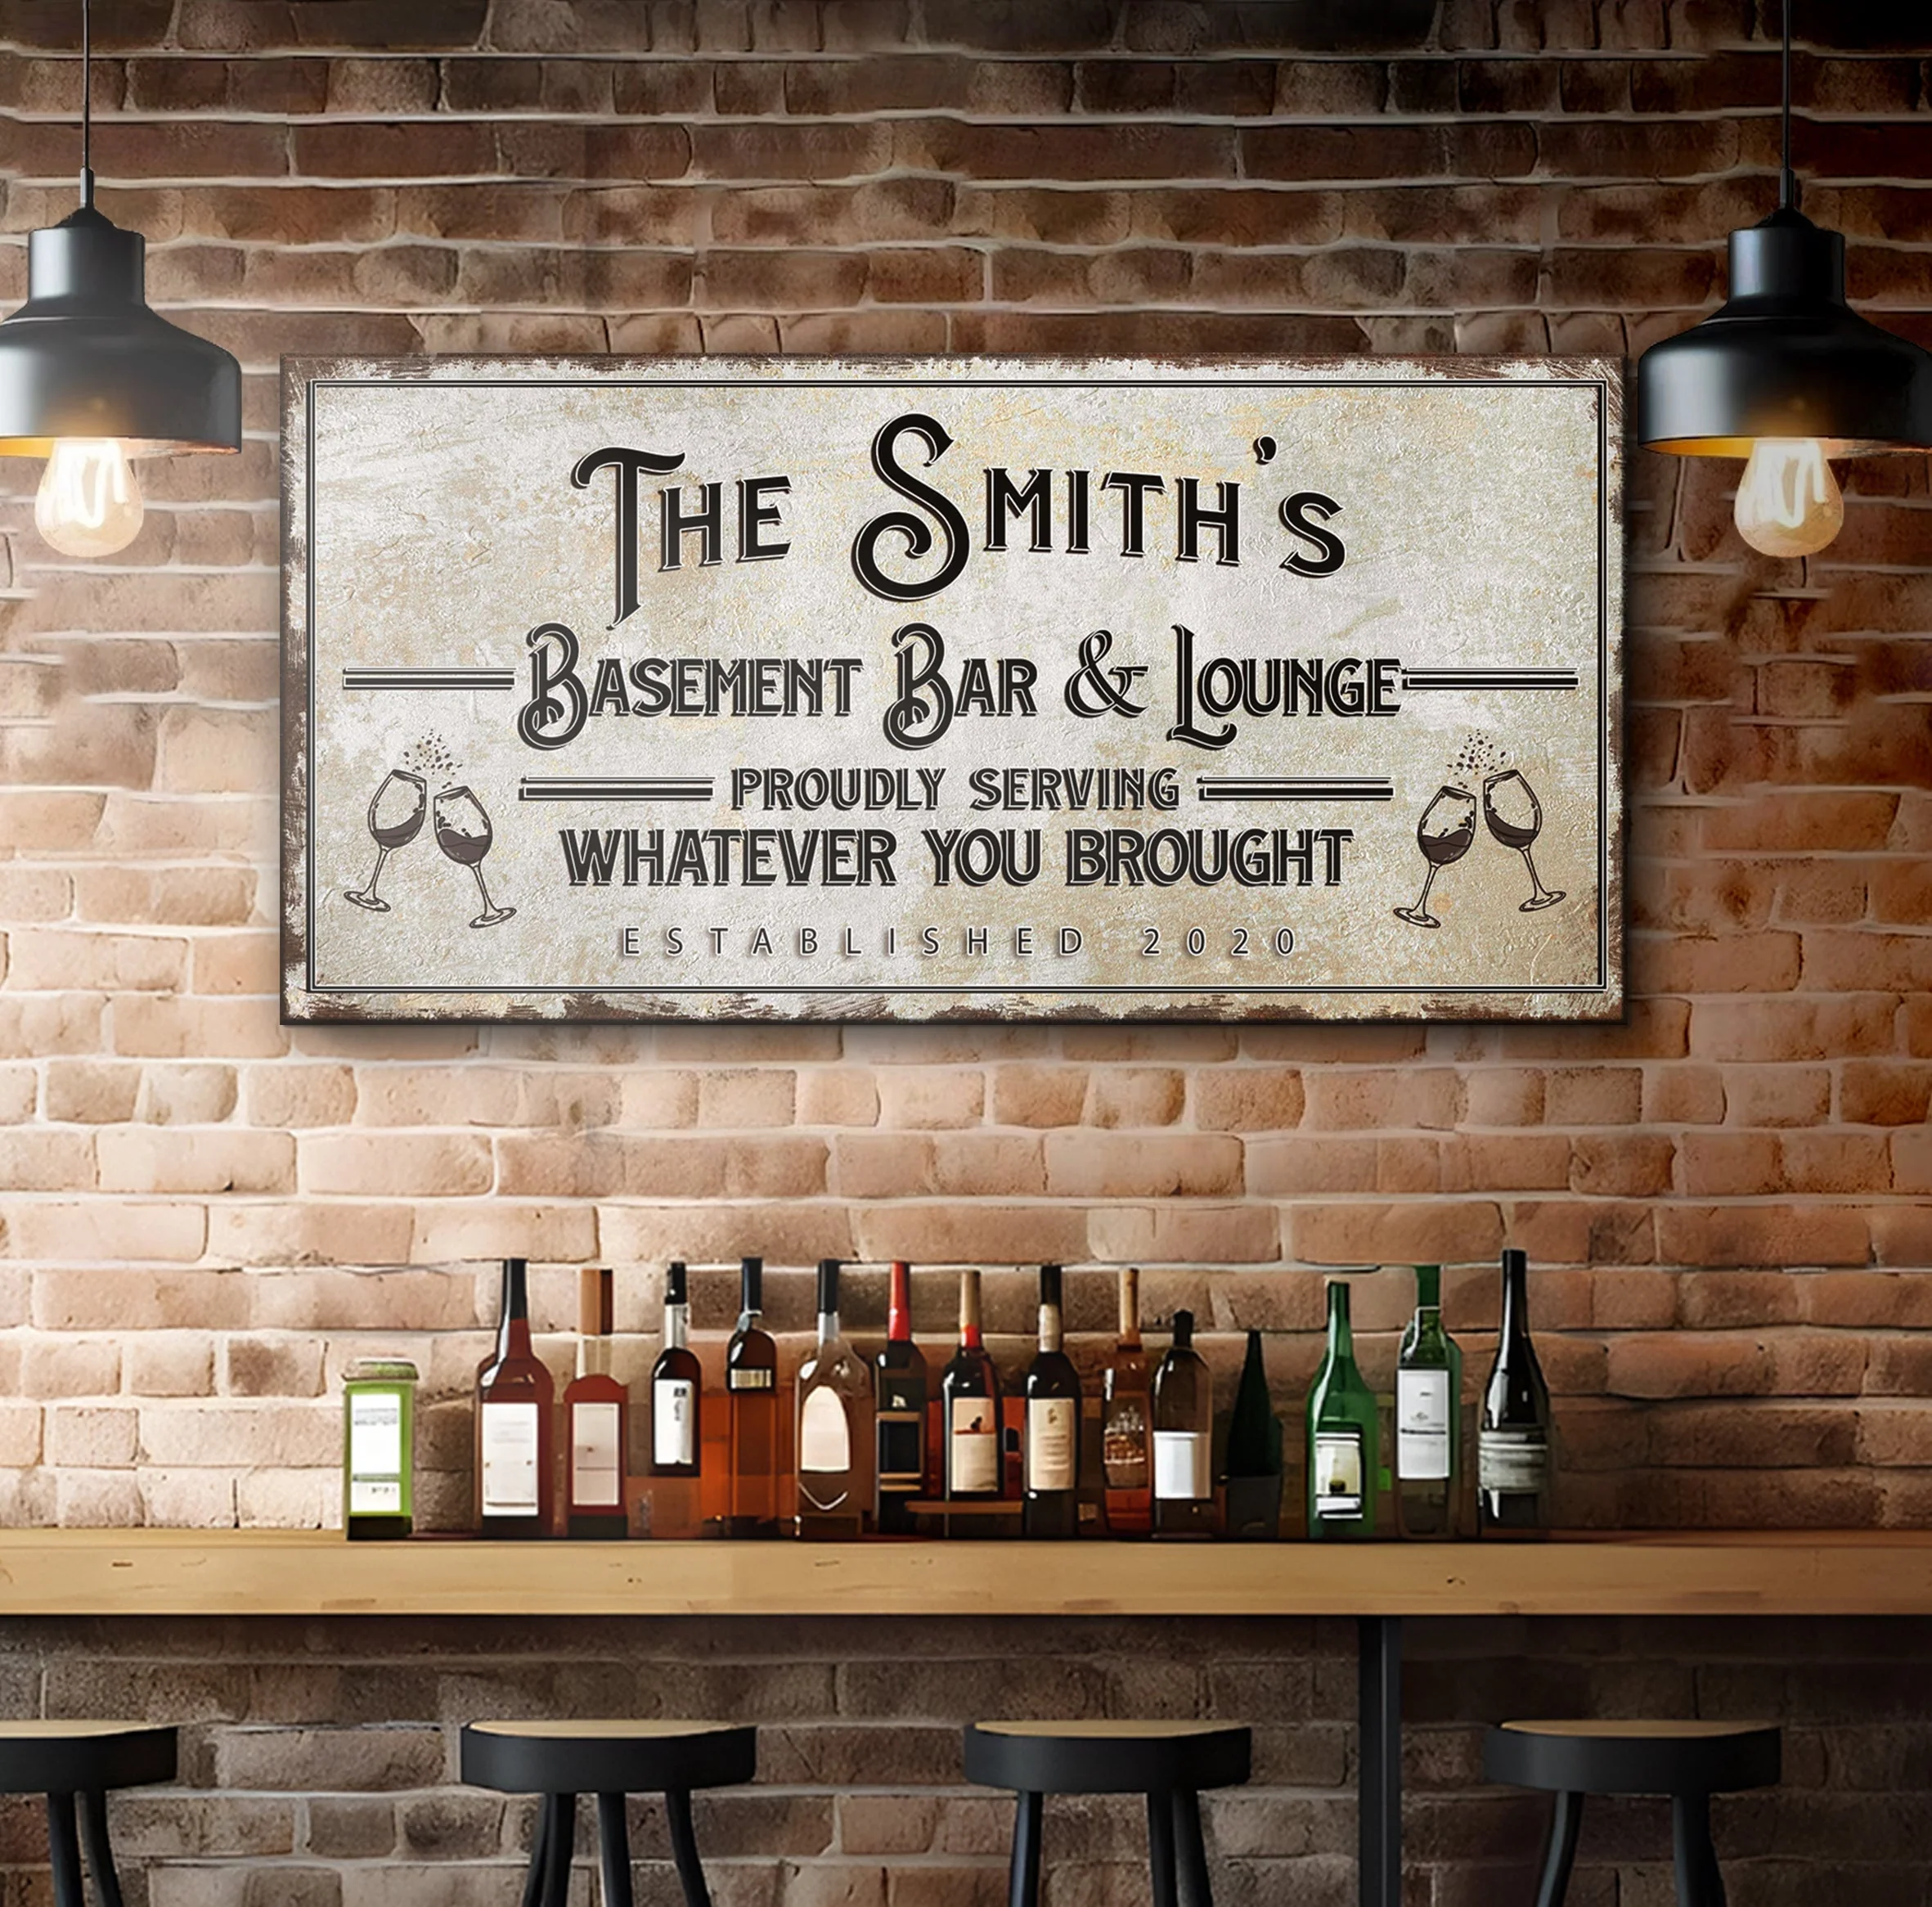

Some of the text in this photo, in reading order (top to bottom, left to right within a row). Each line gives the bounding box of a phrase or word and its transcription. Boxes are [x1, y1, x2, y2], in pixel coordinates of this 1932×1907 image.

[1063, 628, 1149, 718] &
[730, 767, 1180, 812] PROUDLY SERVING
[559, 827, 1354, 888] WHATEVER YOU BROUGHT
[623, 926, 1297, 956] ESTABLISHED 2020
